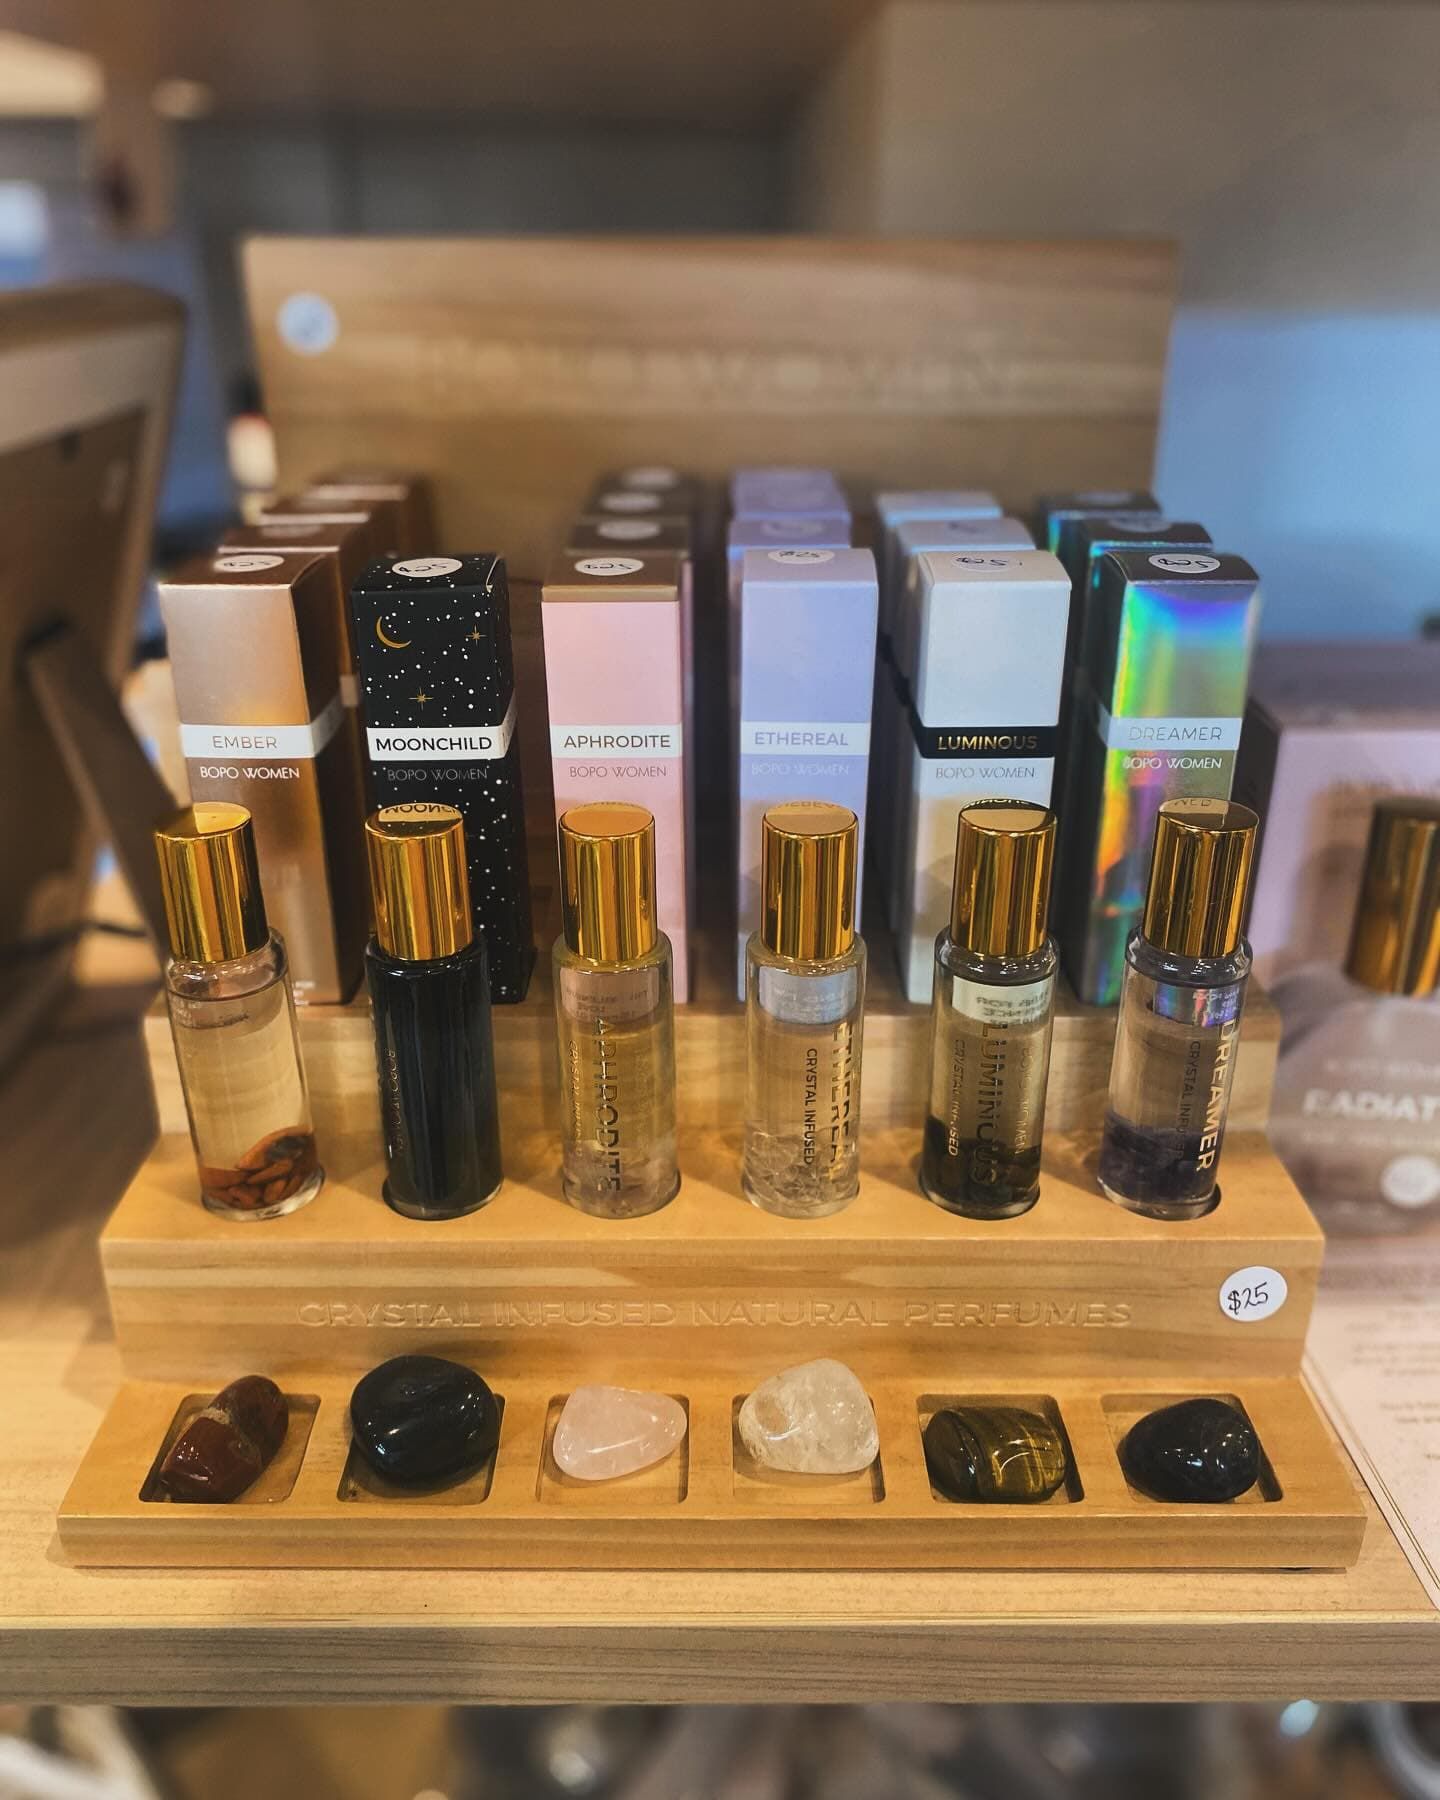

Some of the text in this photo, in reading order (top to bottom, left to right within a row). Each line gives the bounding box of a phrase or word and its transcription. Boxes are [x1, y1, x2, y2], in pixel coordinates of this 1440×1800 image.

[211, 735, 278, 750] EMBER
[563, 734, 671, 750] APHRODITE
[754, 732, 849, 747] ETHEREAL
[1128, 726, 1223, 743] DREAMER
[374, 736, 493, 752] MOONCHILD
[937, 735, 1038, 752] LUMINOUS
[751, 763, 850, 776] BOPO WOMEN
[1122, 756, 1223, 770] BOPO WOMEN
[199, 766, 301, 780] BOPO WOMEN
[386, 768, 488, 783] BOPO WOMEN
[569, 765, 667, 779] BOPO WOMEN
[935, 766, 1035, 780] BOPO WOMEN
[1179, 1040, 1200, 1101] CRYSTAL
[1196, 1019, 1240, 1172] DREAMER
[803, 1047, 818, 1166] CRYSTAL INFUSED
[1228, 1284, 1270, 1315] $25
[299, 1301, 1132, 1328] CRYSTAL INFUSED NATURAL PERFUMES
